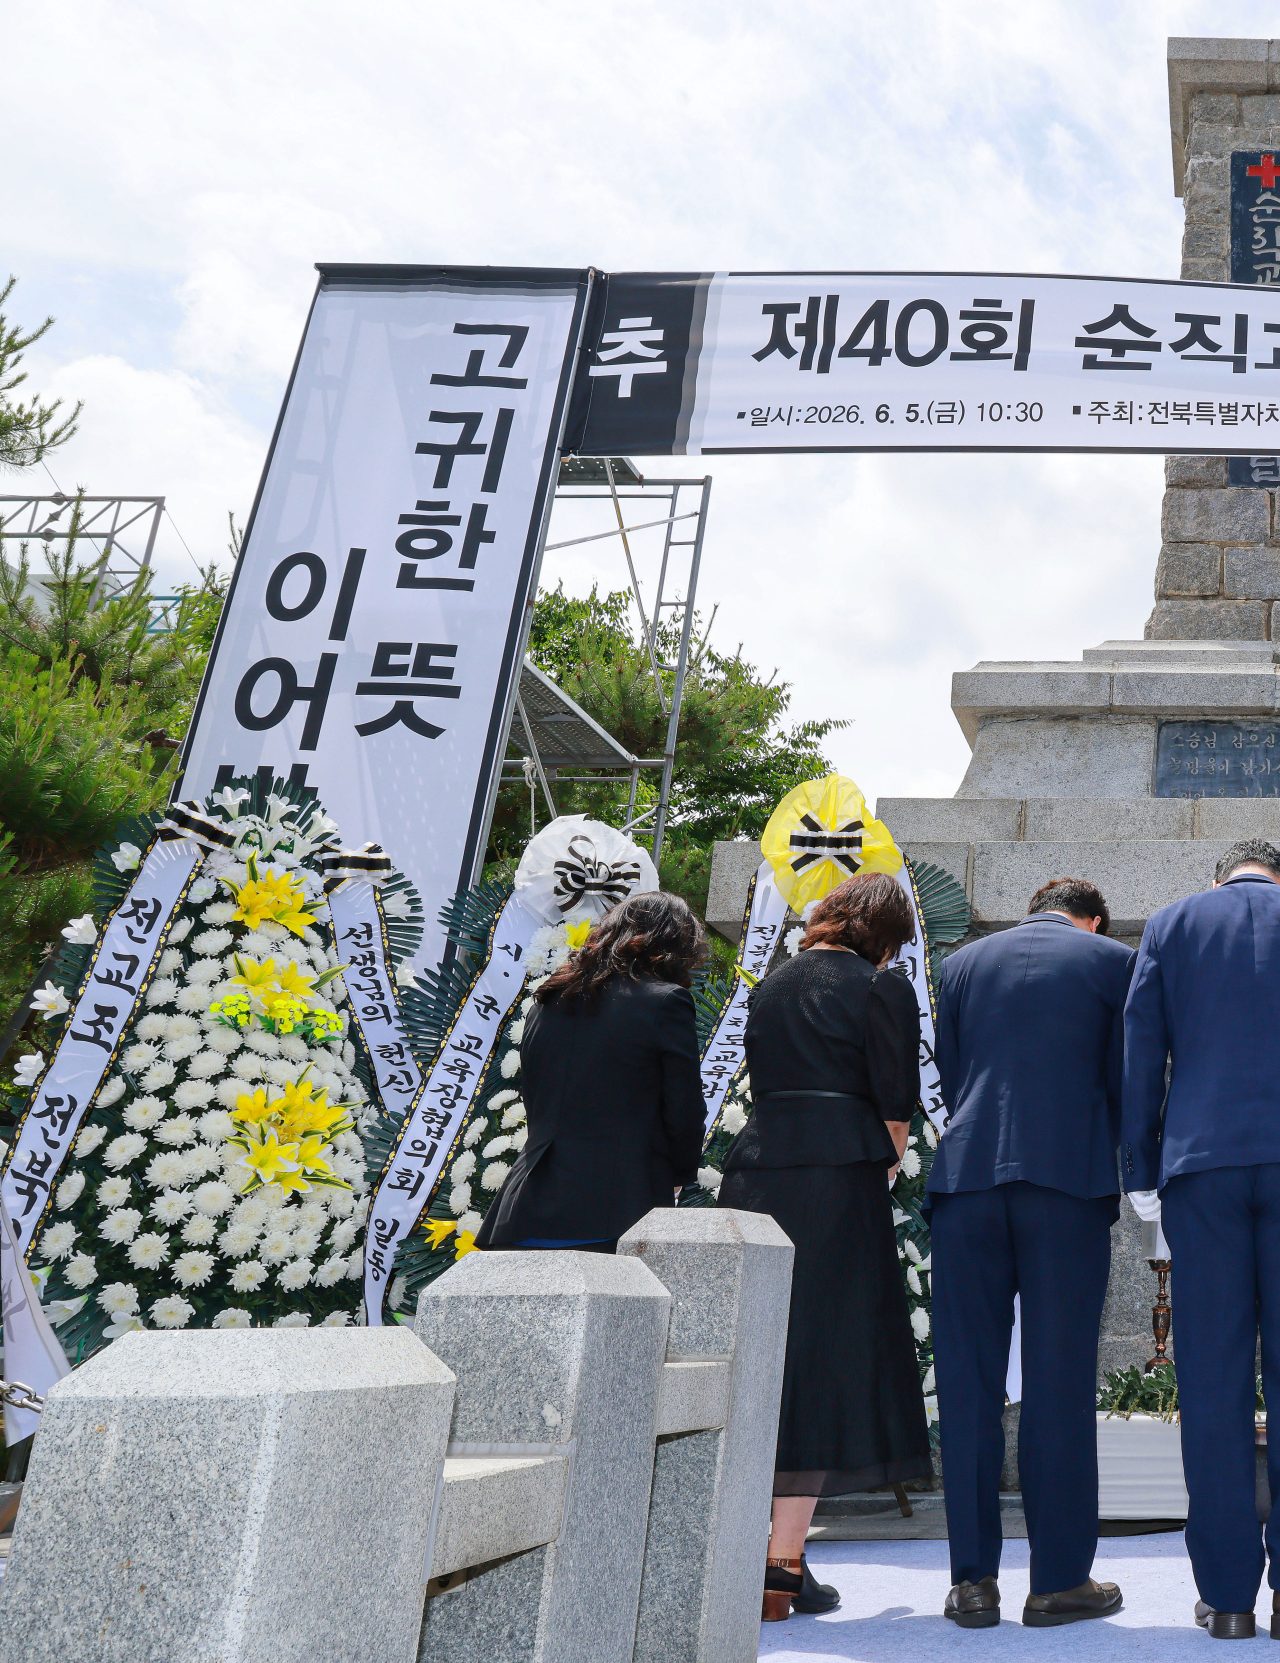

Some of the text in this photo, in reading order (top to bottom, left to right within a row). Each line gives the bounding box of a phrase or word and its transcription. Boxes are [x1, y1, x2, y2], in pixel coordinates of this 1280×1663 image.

[589, 316, 668, 398] 추
[752, 295, 1036, 374] 제40회
[749, 402, 1044, 427] 일시:2026. 6. 5.(금) 10:30
[354, 323, 530, 740] 고귀한 뜻
[1169, 731, 1217, 749] 스승님
[340, 922, 417, 1094] 선생님의 헌신
[10, 897, 162, 1241] 전교조 전북
[387, 1033, 484, 1201] 교육장협의회
[367, 1218, 400, 1282] 일동
